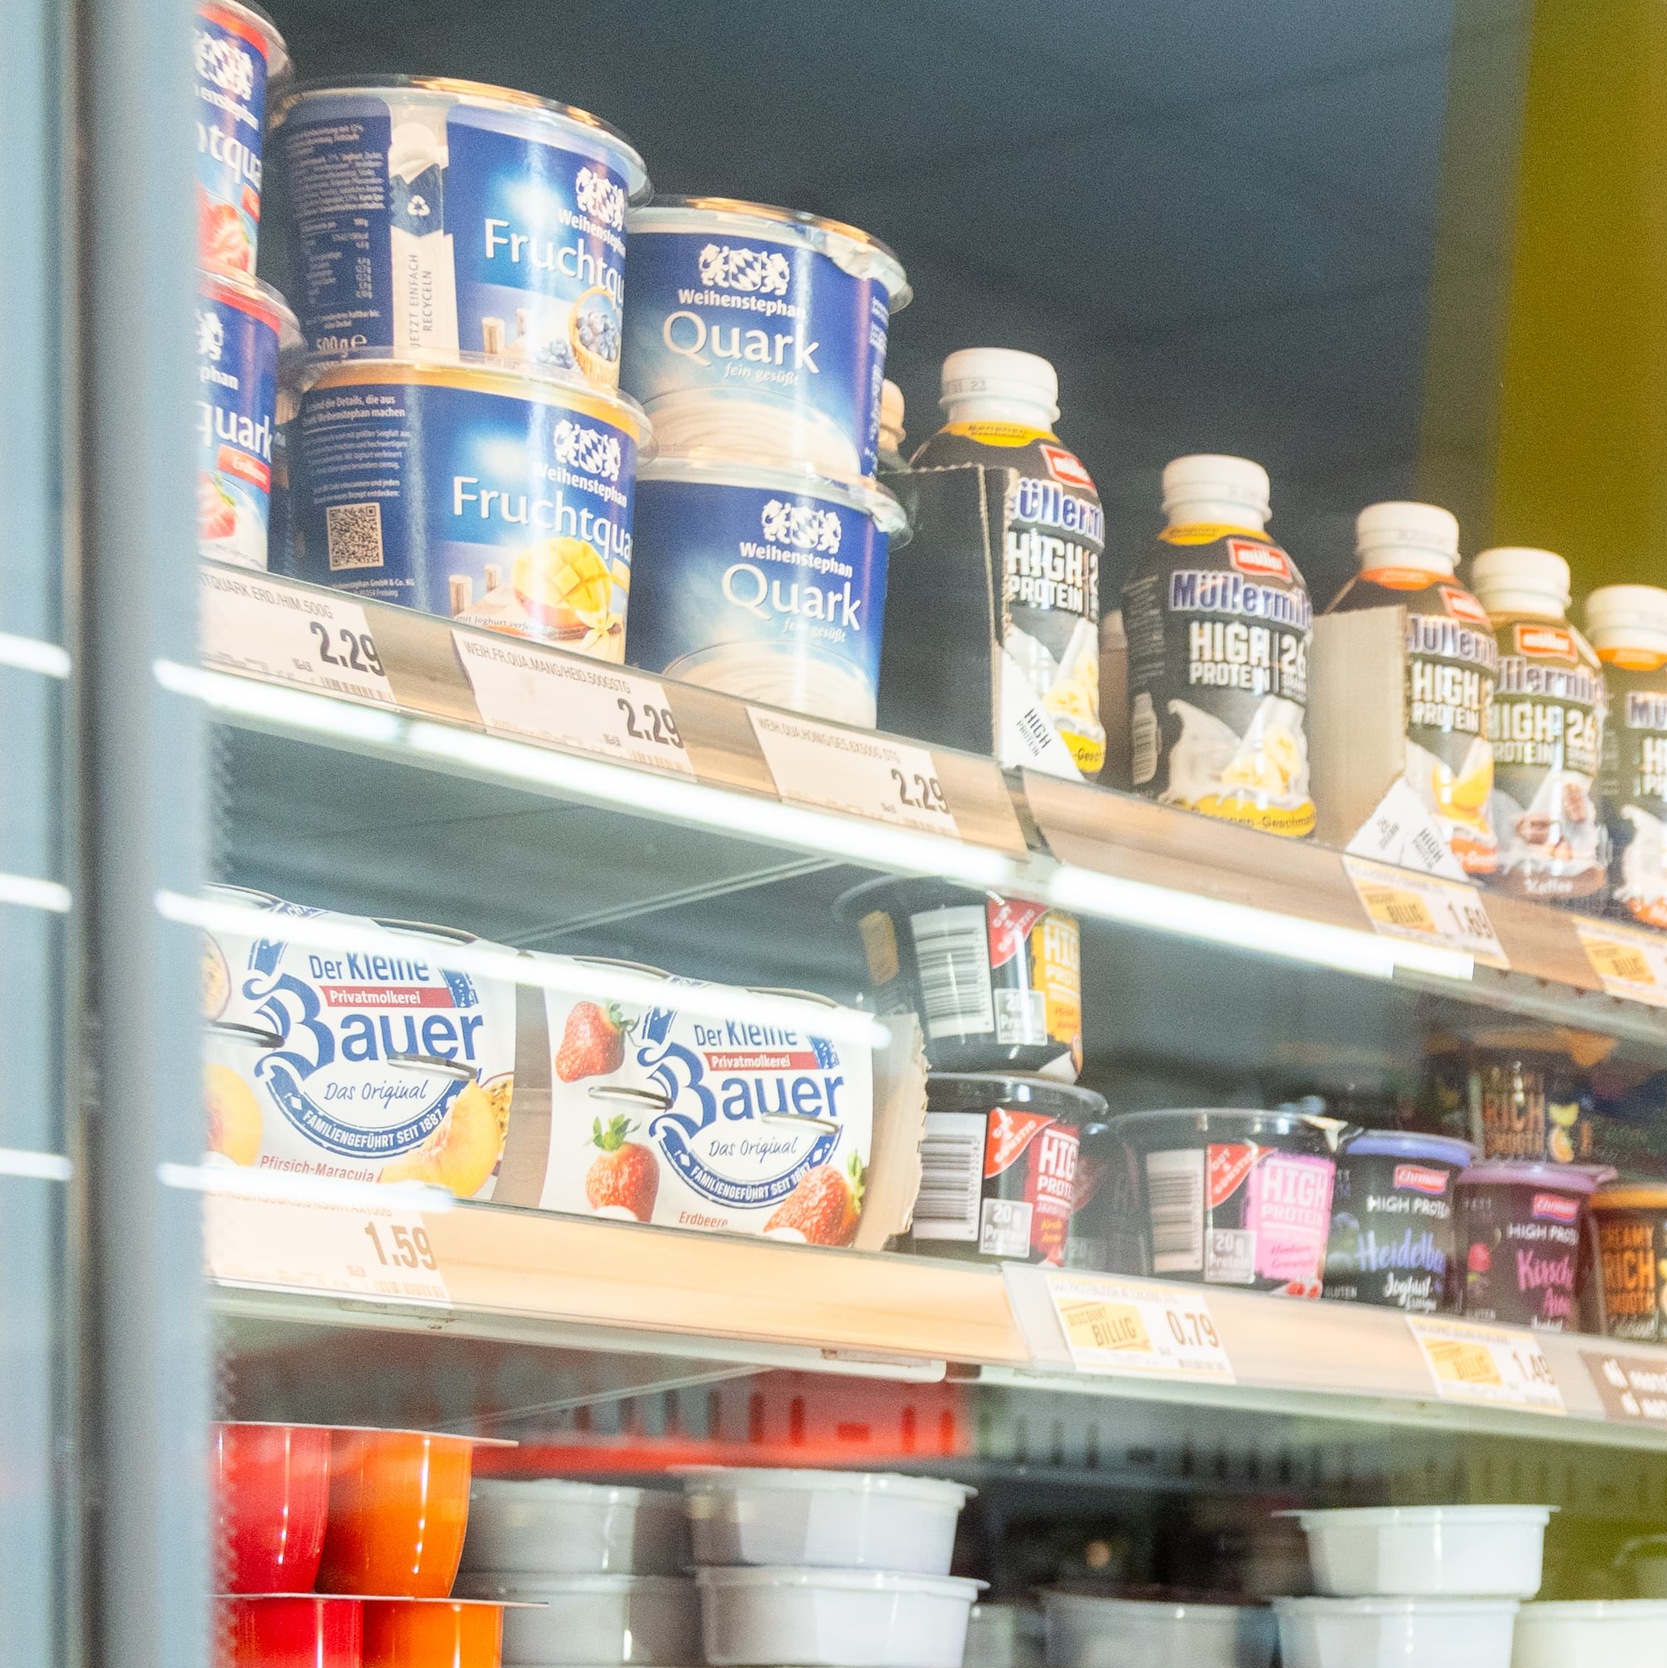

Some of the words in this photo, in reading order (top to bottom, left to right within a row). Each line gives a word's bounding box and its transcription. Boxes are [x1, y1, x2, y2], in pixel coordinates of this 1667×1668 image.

[678, 289, 806, 320] Weihenstephan
[663, 311, 819, 374] Quark
[533, 461, 628, 508] Weihenstephan
[739, 542, 853, 578] Weihenstephan
[1009, 531, 1084, 588] HIGH
[722, 563, 861, 631] Quark
[1008, 573, 1084, 614] PROTEIN
[310, 620, 387, 678] 2.29
[1189, 620, 1271, 667] HIGH
[1189, 661, 1271, 693] PROTEIN
[1411, 662, 1480, 709] HIGH
[617, 697, 685, 750] 2.29
[1023, 708, 1052, 750] HIGH
[1411, 701, 1480, 733] PROTEIN
[891, 767, 951, 815] 2.29
[309, 955, 343, 981] Der
[348, 951, 430, 982] Kleine
[330, 990, 421, 1006] Privatmolkerei
[242, 972, 485, 1081] Bauer
[694, 1024, 722, 1046] Der
[711, 1054, 791, 1070] Privatmolkerei
[323, 1081, 356, 1101] Das
[361, 1078, 430, 1110] Original
[637, 1042, 844, 1139] Bauer
[396, 1122, 420, 1146] SEIT
[419, 1109, 444, 1134] 1887
[708, 1139, 736, 1158] Das
[740, 1136, 797, 1164] Original
[678, 1210, 729, 1228] Erdbeere
[1367, 1195, 1410, 1214] HIGH
[364, 1220, 438, 1271] 1.59
[1091, 1316, 1138, 1347] BILLIG
[1166, 1309, 1220, 1349] 0.79
